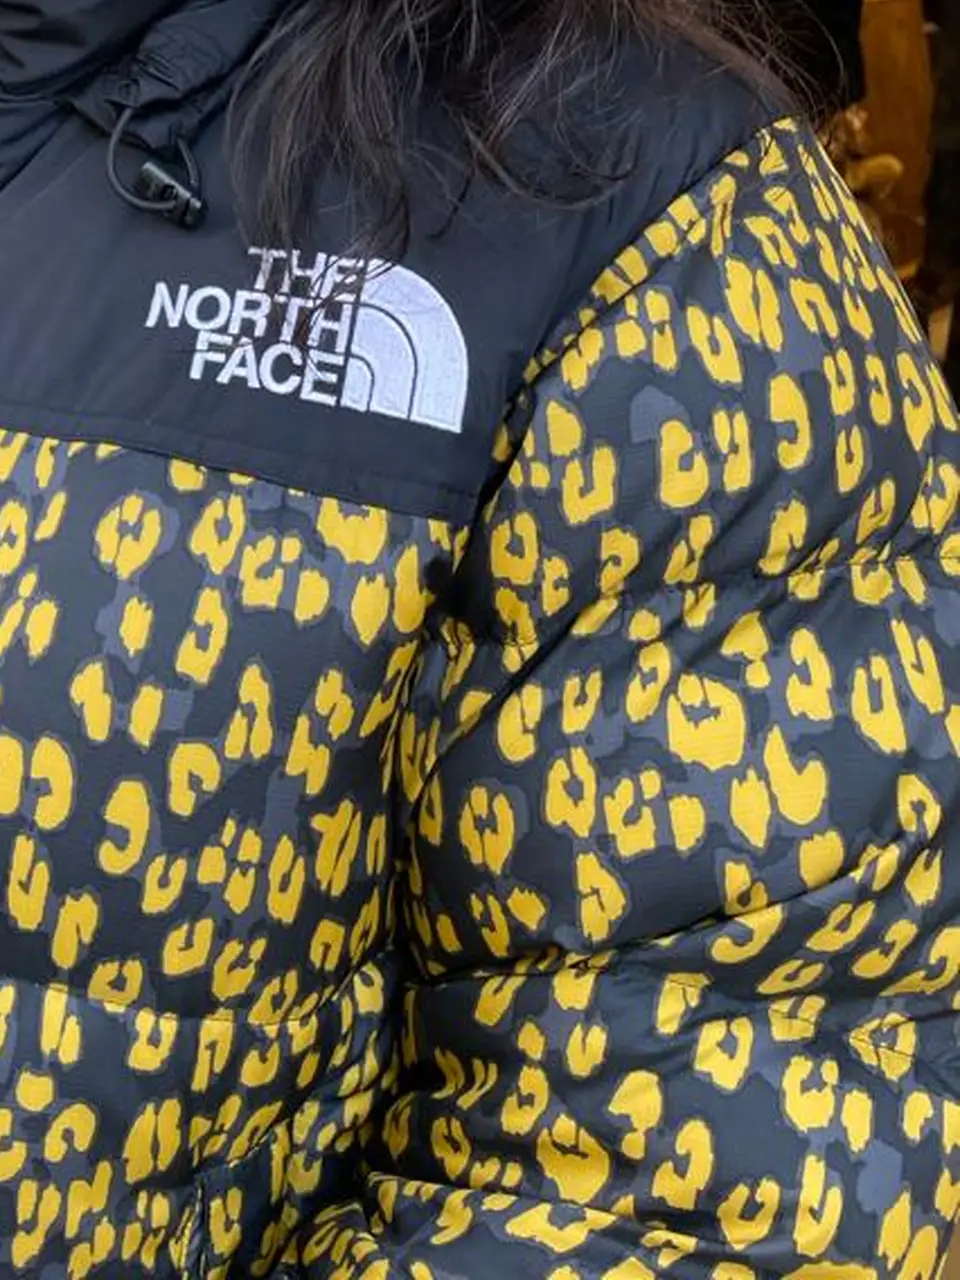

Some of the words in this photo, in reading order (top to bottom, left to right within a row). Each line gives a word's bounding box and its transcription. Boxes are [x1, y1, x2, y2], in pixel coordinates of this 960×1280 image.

[248, 246, 364, 301] THE
[144, 281, 353, 353] NORTH
[189, 330, 344, 406] FACE
